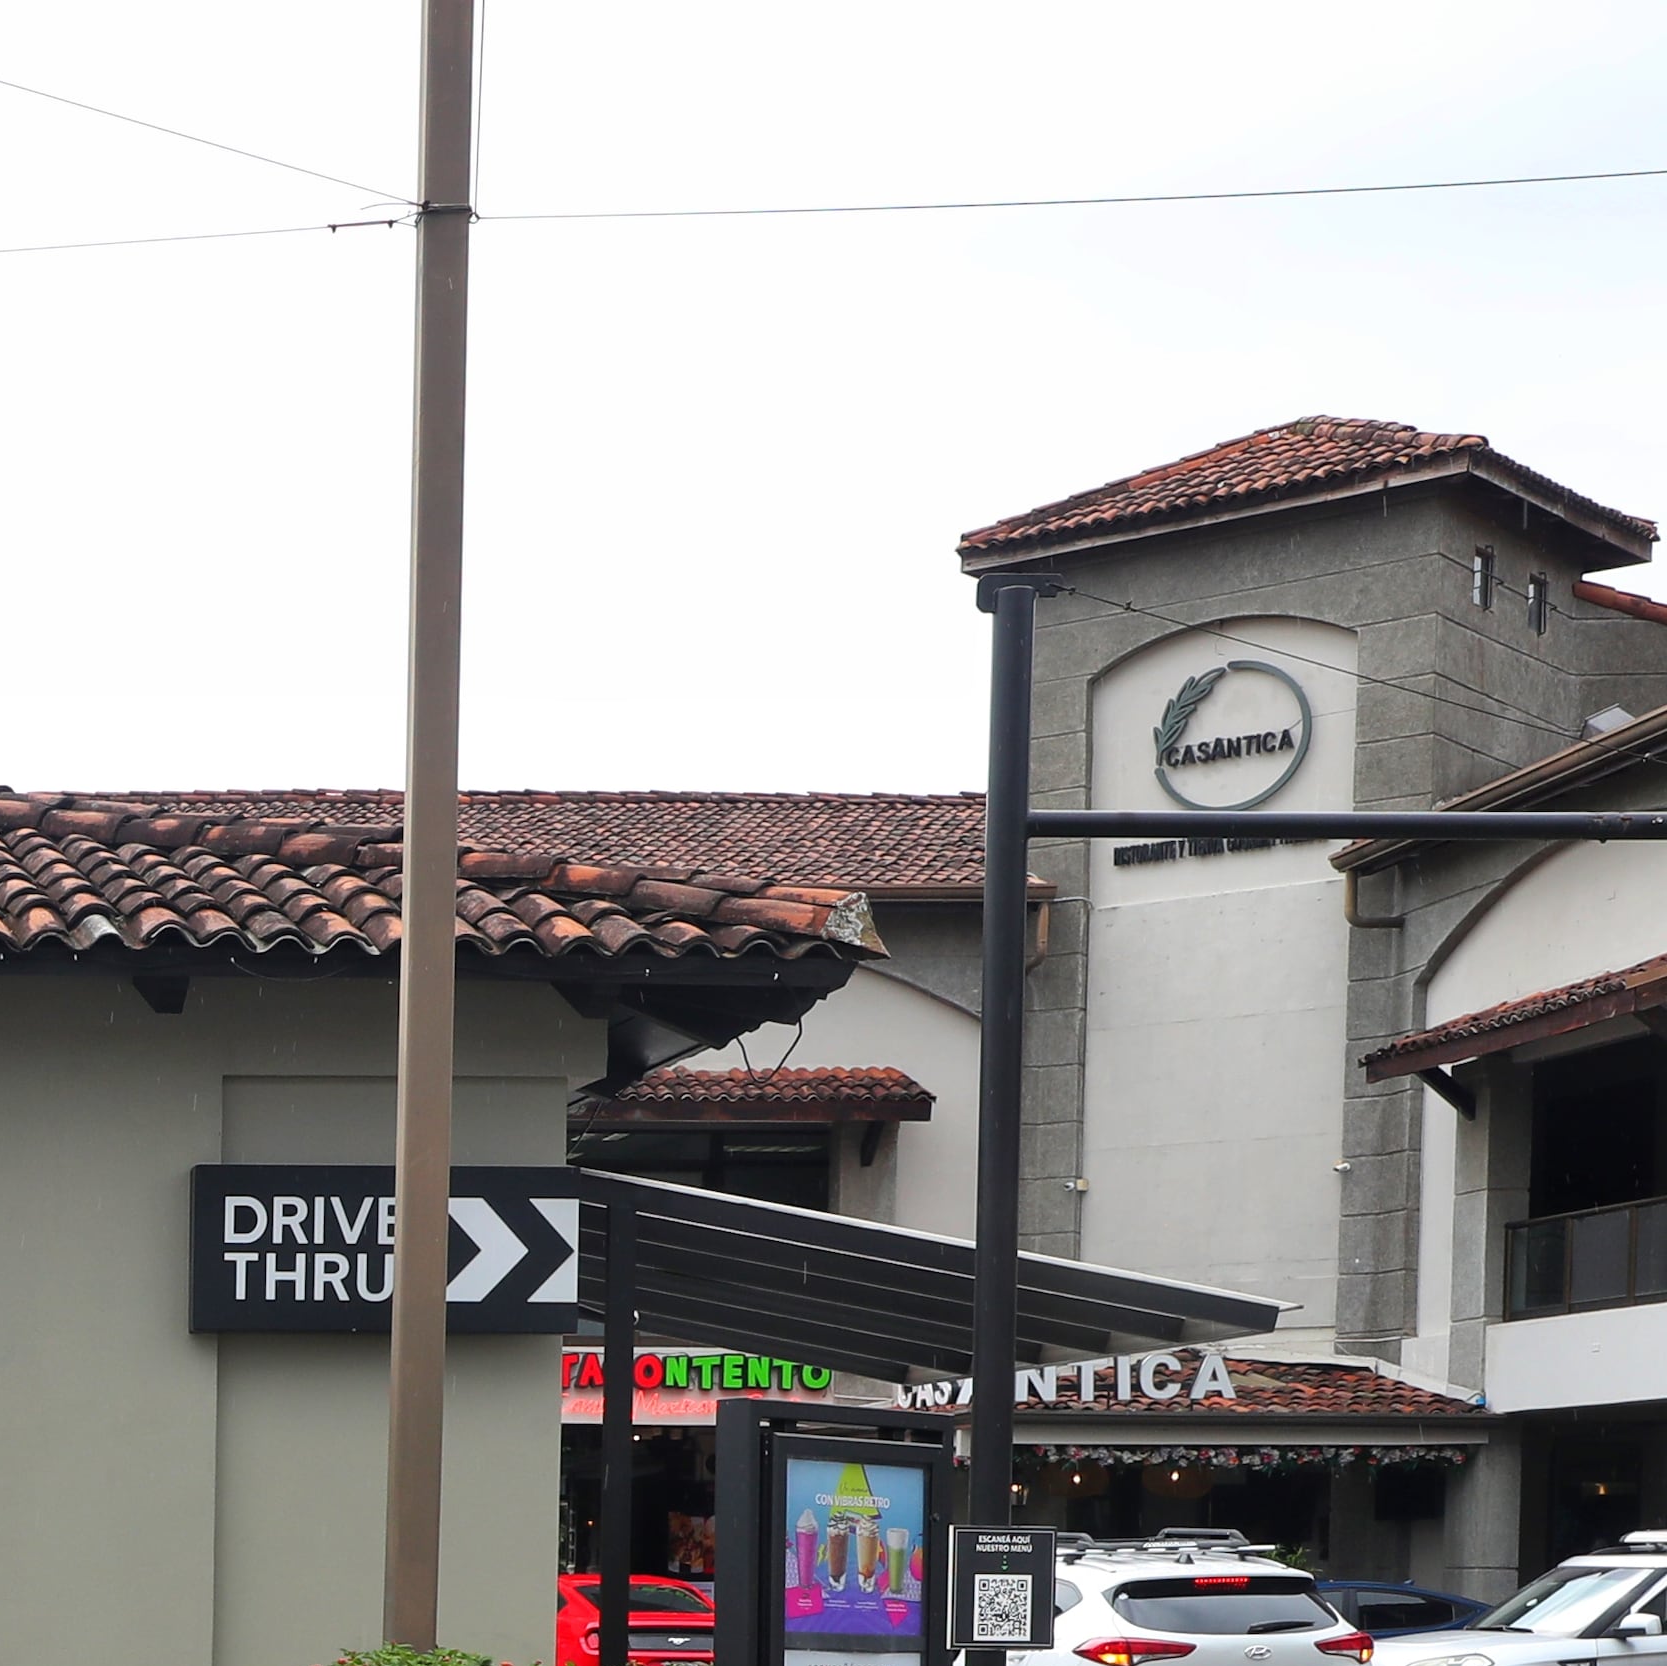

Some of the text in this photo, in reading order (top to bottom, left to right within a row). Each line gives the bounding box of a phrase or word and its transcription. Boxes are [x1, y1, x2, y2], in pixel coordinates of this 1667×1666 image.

[1167, 729, 1295, 767] CASANTICA
[223, 1195, 396, 1245] DRIVE
[223, 1252, 395, 1302] THRU
[562, 1353, 832, 1390] TAONTENTO
[815, 1493, 833, 1506] CON
[976, 1544, 1009, 1552] NUESTRO
